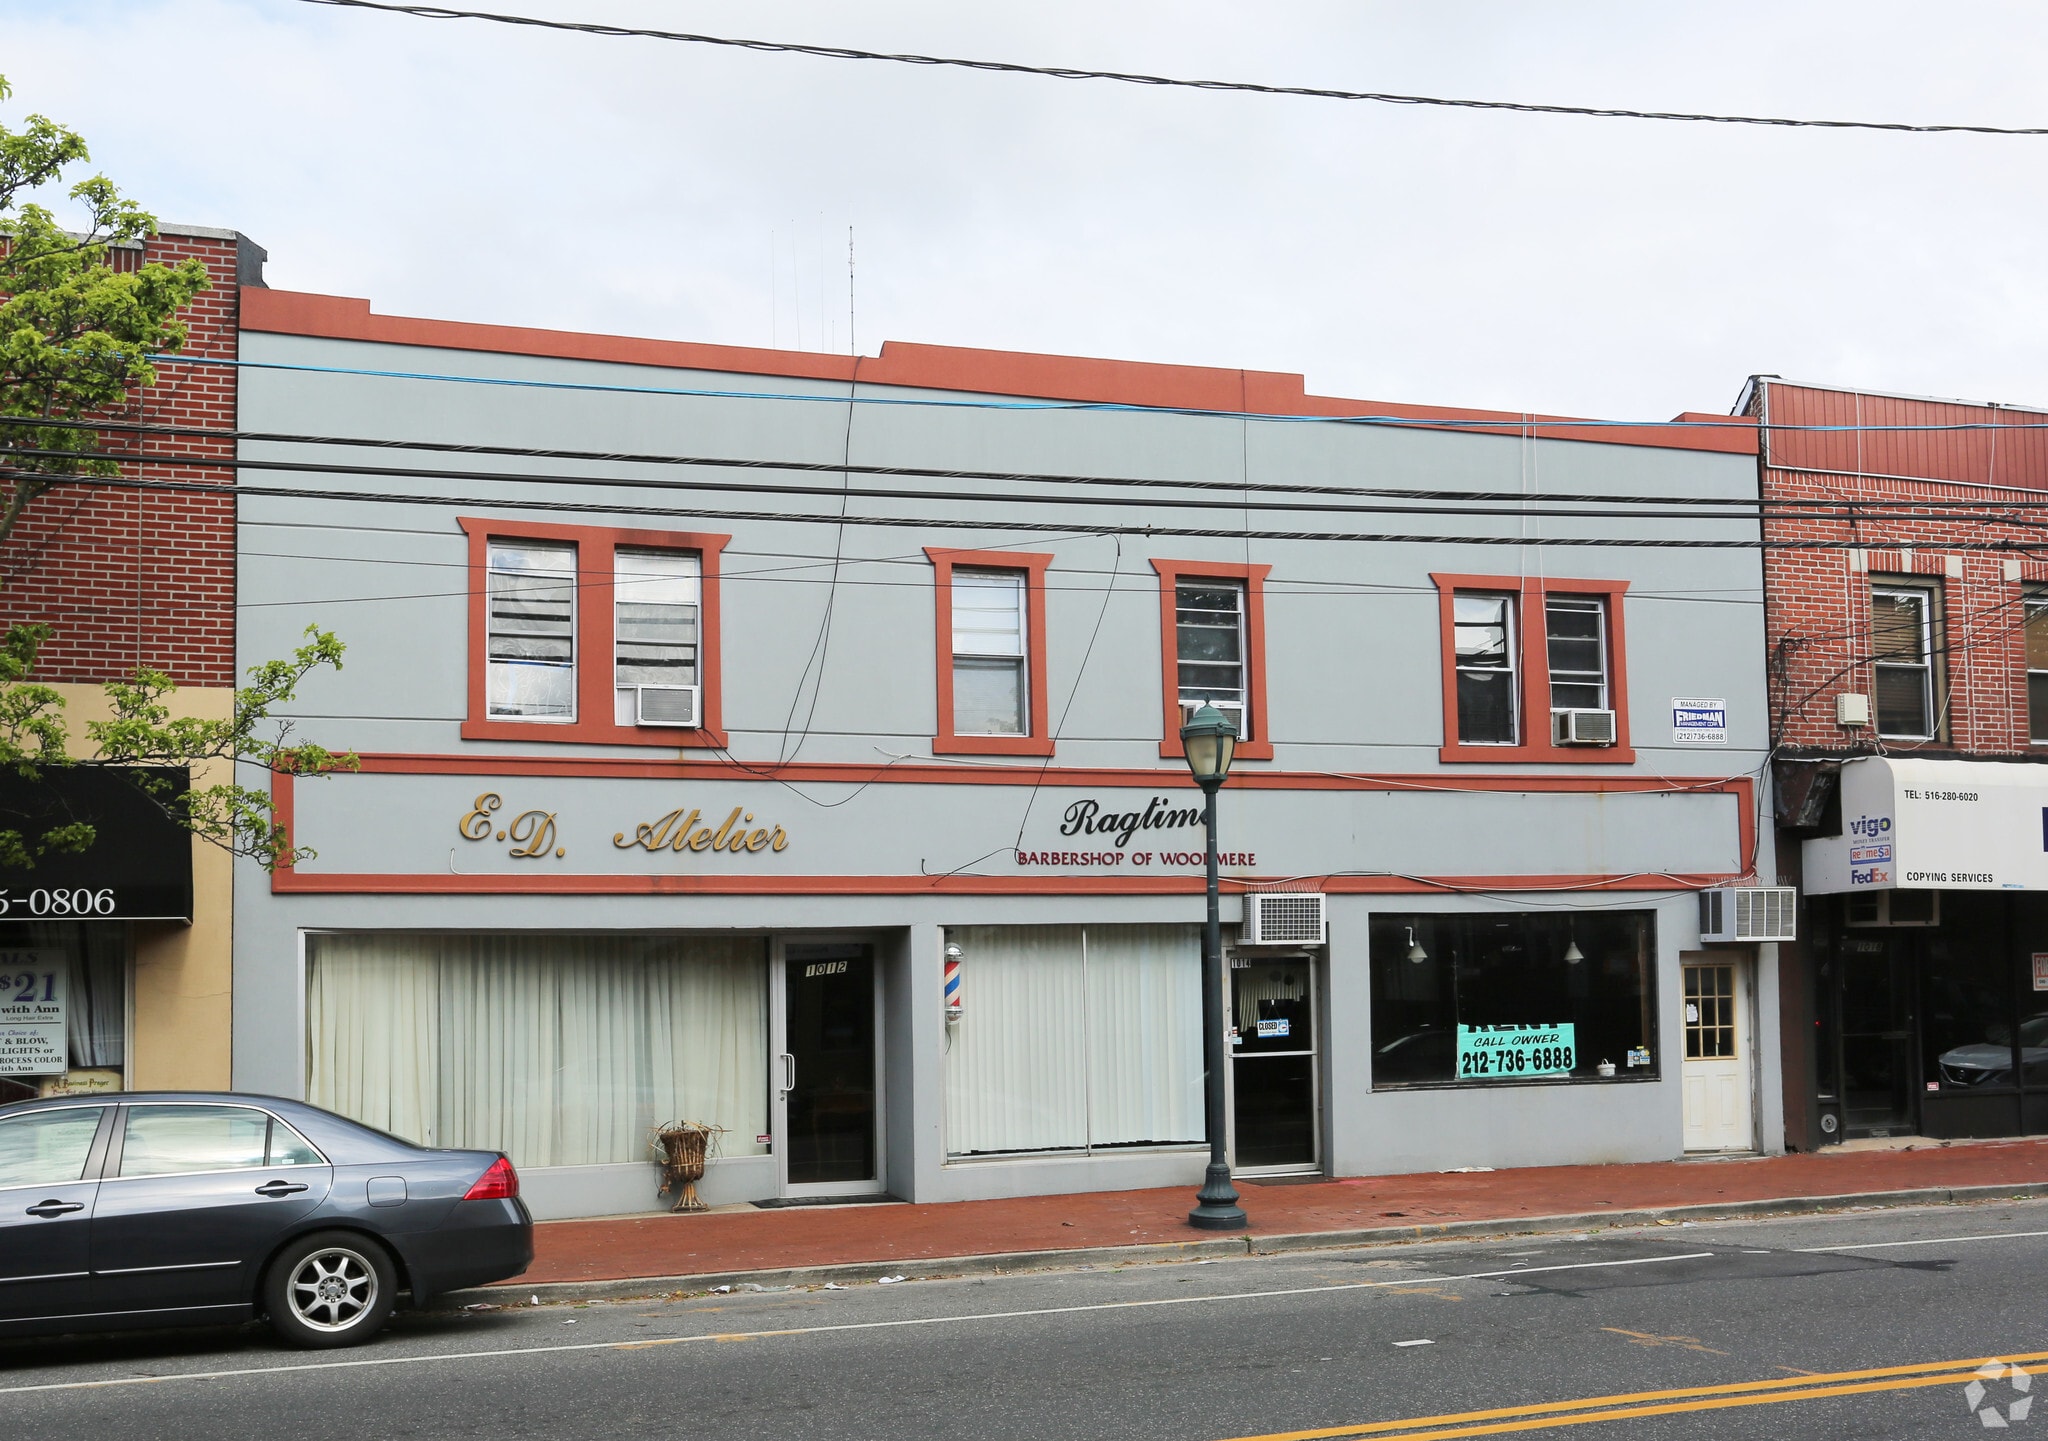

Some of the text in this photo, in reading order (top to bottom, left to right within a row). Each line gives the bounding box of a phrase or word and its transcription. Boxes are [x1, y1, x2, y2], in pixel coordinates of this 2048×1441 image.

[1676, 711, 1723, 727] FRIEDMAN
[1904, 790, 1978, 801] TEL: 516-280-6020
[613, 806, 789, 852] Atelier
[1850, 815, 1891, 837] vigo
[1018, 852, 1124, 866] BARBERSHOP
[1132, 853, 1152, 865] OF
[1851, 867, 1889, 884] FedEx
[1906, 872, 1993, 883] COPYING SERVICES
[805, 961, 848, 977] 1012
[1, 1005, 60, 1013] with Ann
[1258, 1022, 1278, 1031] CLOSED
[16, 1037, 49, 1045] BLOW,
[1473, 1034, 1559, 1047] CALL OWNER
[0, 1047, 41, 1055] LIGHTS
[34, 1056, 63, 1064] COLOR
[1462, 1046, 1573, 1074] 212-736-6888
